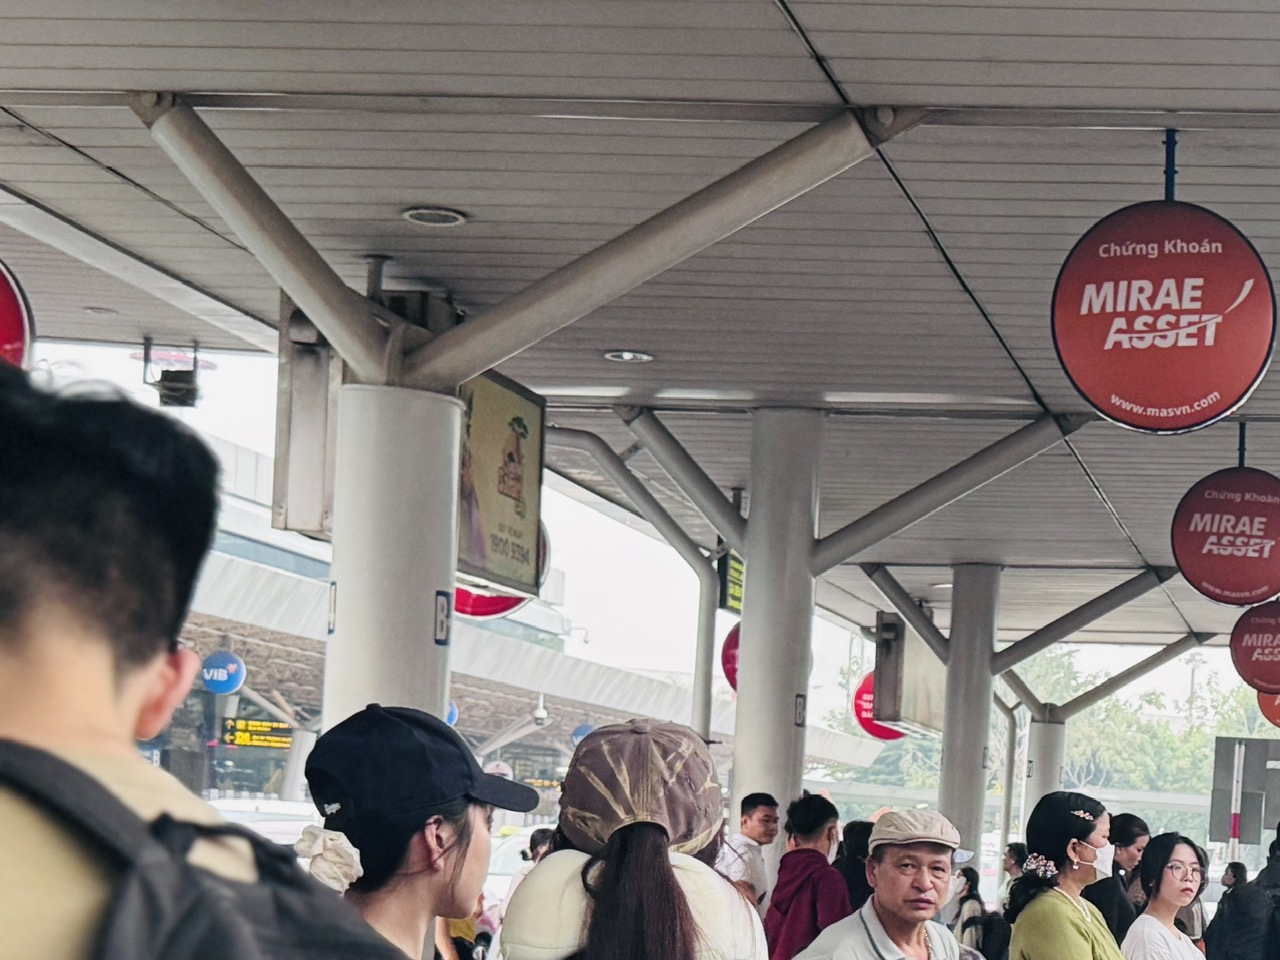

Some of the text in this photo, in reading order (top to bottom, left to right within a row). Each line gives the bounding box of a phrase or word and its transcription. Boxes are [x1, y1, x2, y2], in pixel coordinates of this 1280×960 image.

[1099, 238, 1223, 258] Chứng Khoán
[1080, 277, 1204, 315] MIRAE
[1104, 313, 1223, 350] ASSET
[1111, 390, 1221, 417] www.masvn.com
[1189, 512, 1267, 536] MIRAE
[1202, 535, 1276, 559] ASSET
[203, 668, 229, 681] VIB
